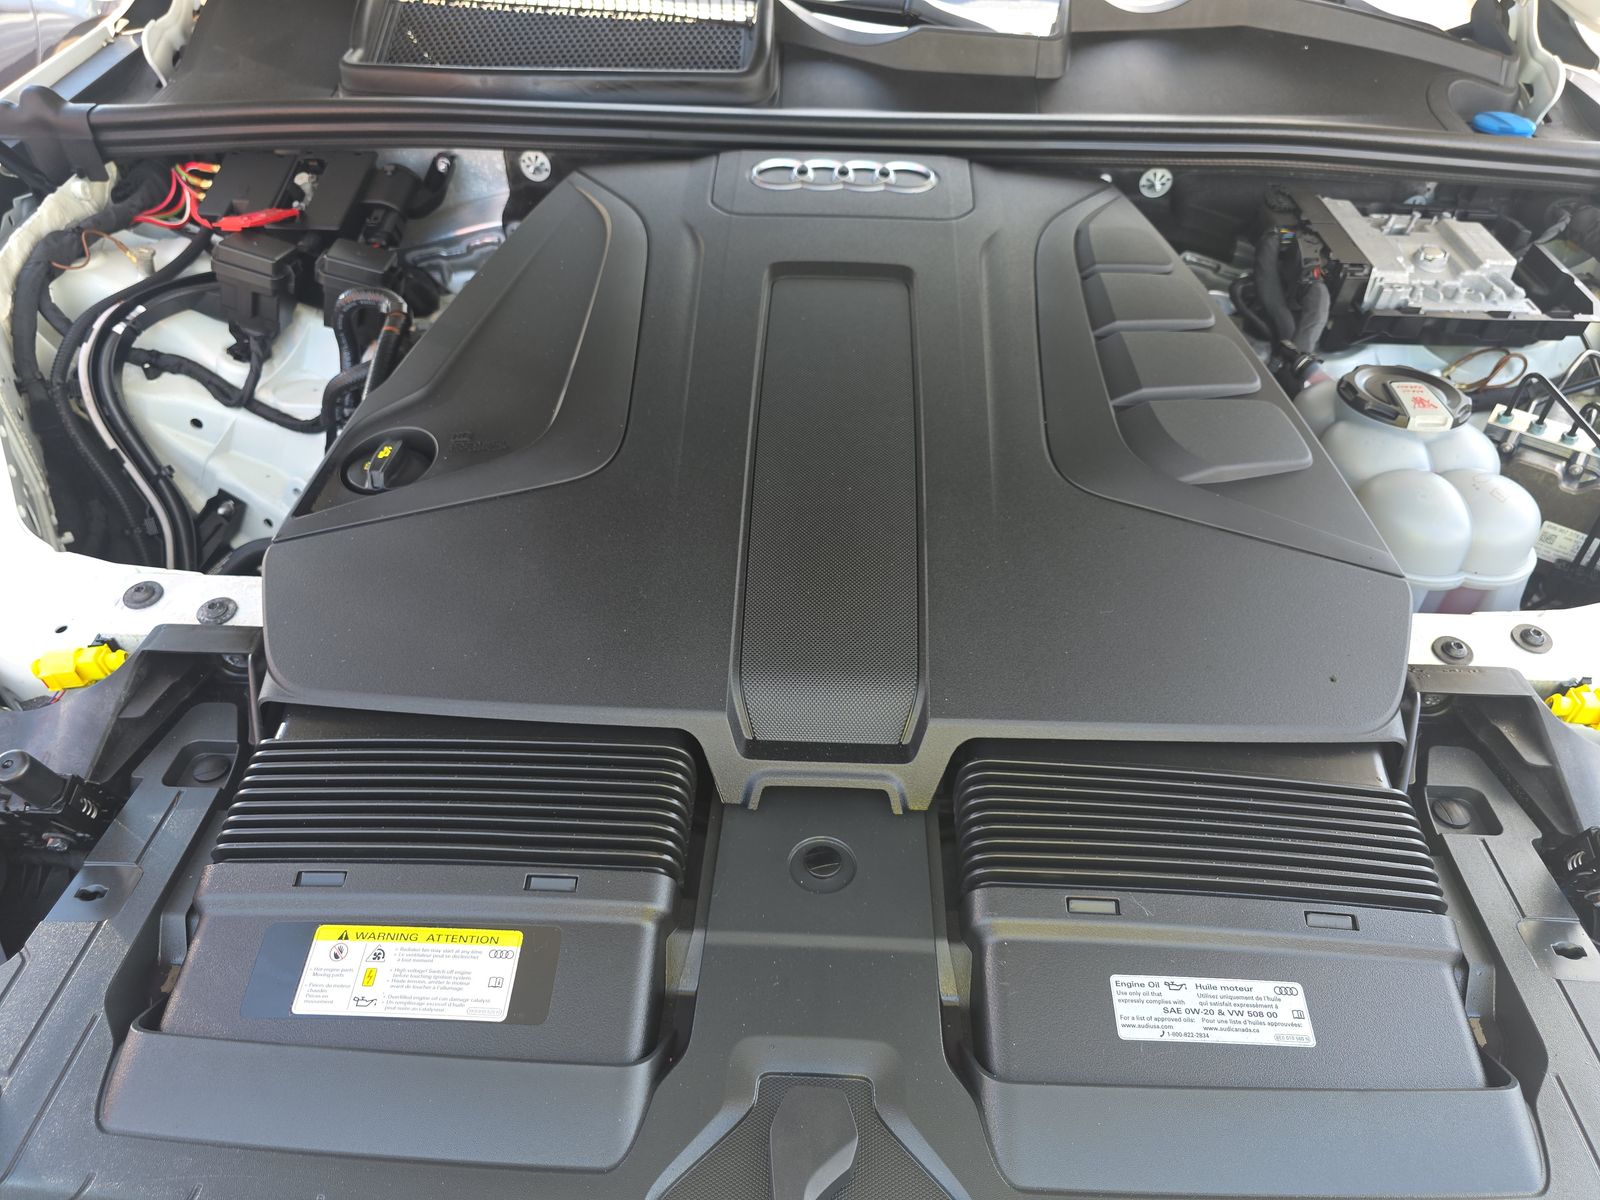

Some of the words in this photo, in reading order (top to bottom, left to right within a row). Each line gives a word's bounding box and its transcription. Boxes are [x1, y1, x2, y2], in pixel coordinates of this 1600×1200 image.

[355, 931, 419, 942] WARNING
[426, 933, 500, 945] ATTENTION
[1114, 980, 1146, 988] Engine
[1184, 1007, 1215, 1016] 0W-20
